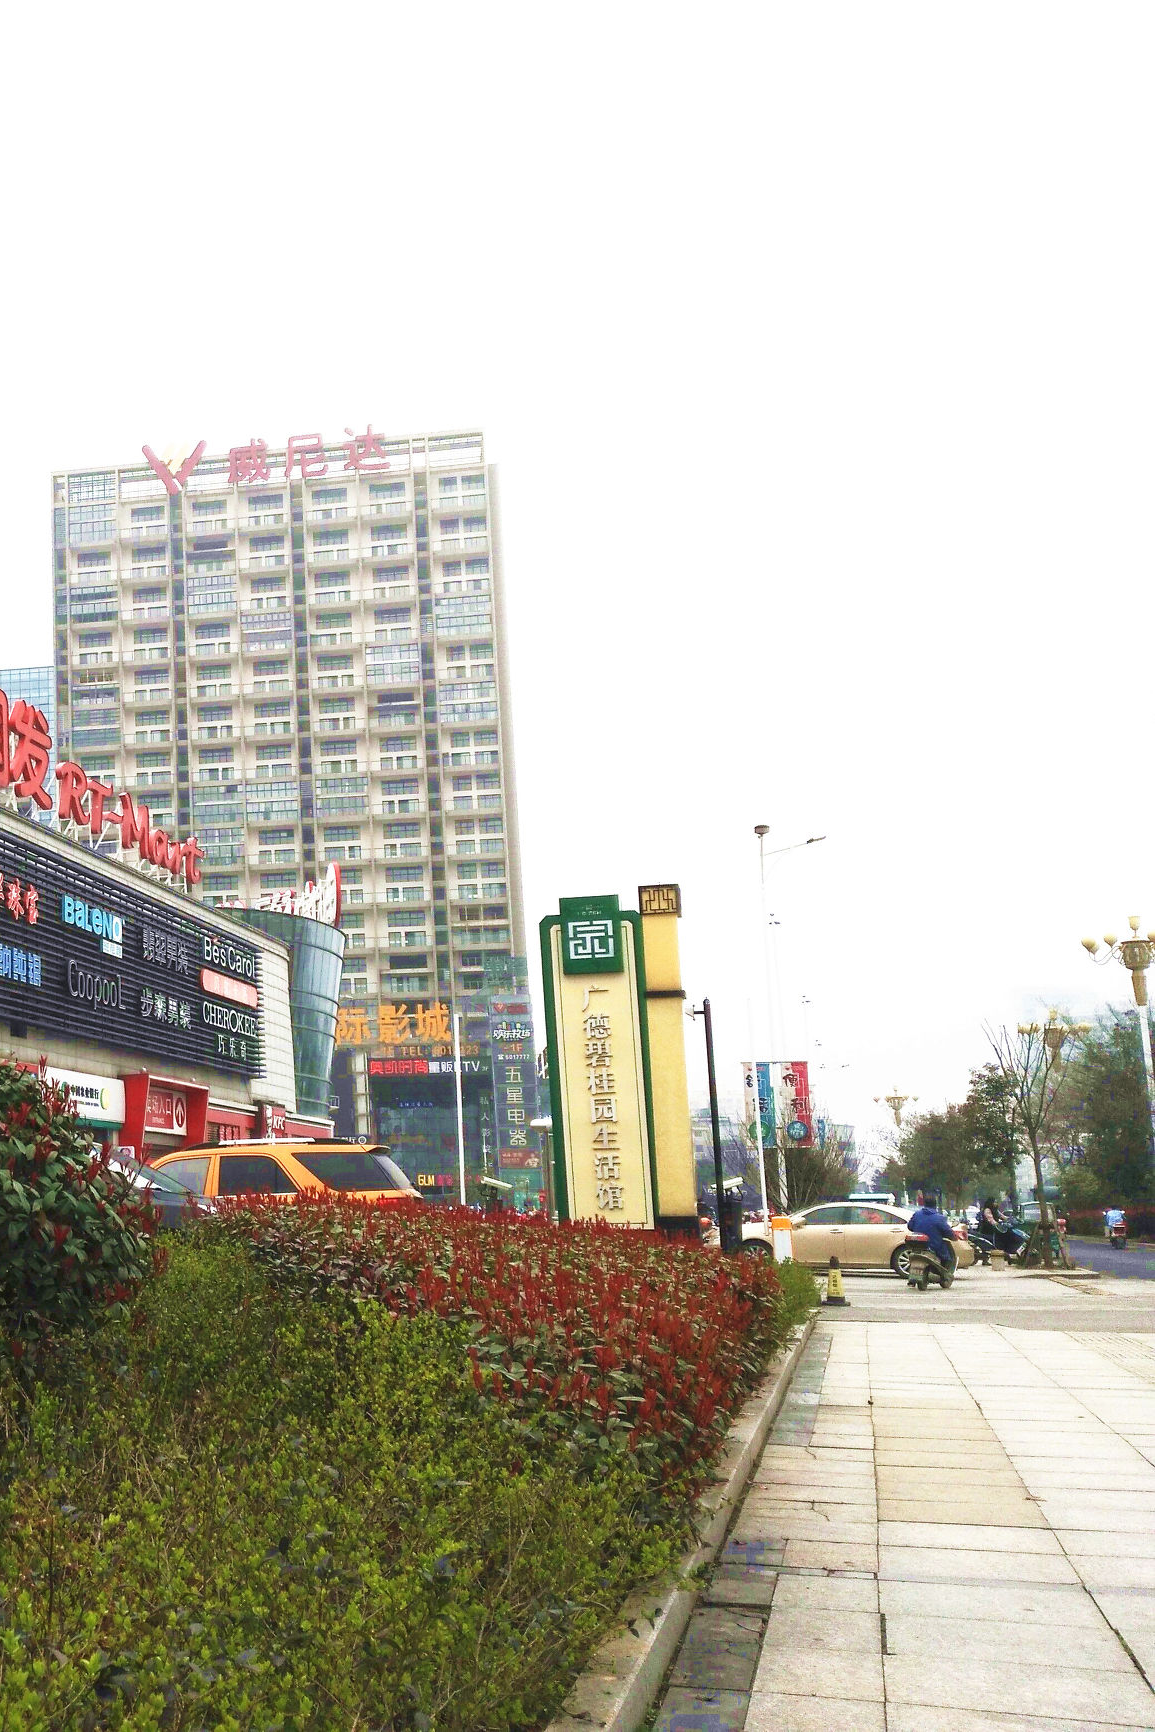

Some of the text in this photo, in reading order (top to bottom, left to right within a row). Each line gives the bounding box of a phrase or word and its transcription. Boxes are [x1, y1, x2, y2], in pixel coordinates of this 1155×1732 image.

[229, 424, 391, 483] 威尼达
[55, 761, 206, 884] RT-Mart
[202, 1001, 258, 1038] CHEROKEE
[273, 1115, 286, 1130] KFC
[505, 1066, 527, 1147] 五星电器
[582, 984, 625, 1211] 广德碧桂园生活馆
